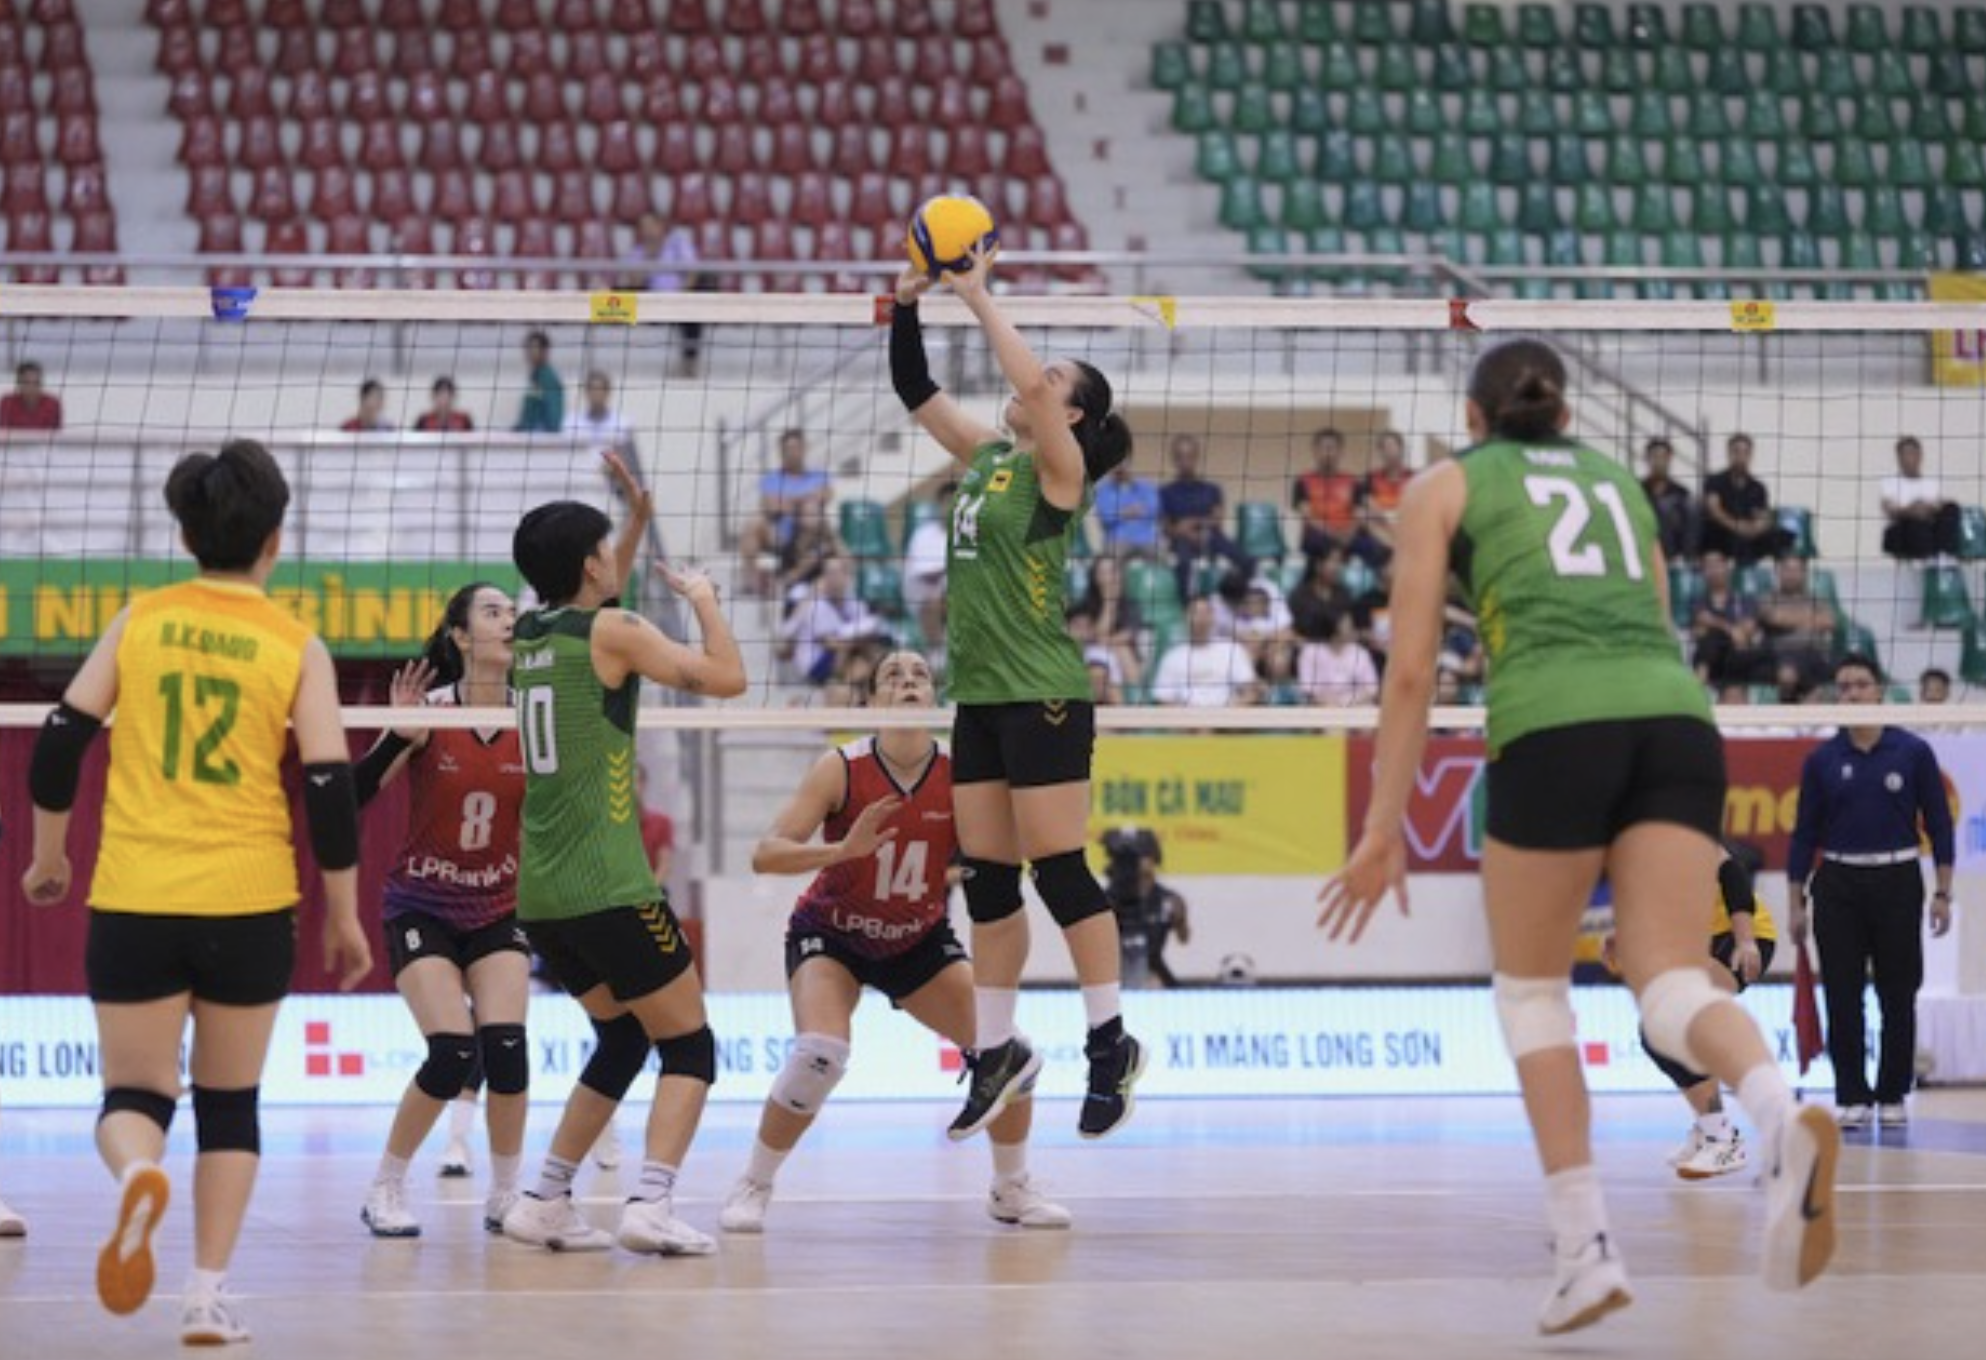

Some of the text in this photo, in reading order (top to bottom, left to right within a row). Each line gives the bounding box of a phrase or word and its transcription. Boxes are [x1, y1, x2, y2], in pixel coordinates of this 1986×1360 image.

[953, 492, 985, 547] 14
[1523, 474, 1643, 581] 21
[159, 671, 242, 787] 12
[516, 684, 559, 775] 10
[460, 791, 497, 851] 8
[874, 840, 929, 903] 14
[405, 928, 422, 950] 8
[800, 937, 824, 955] 14
[832, 907, 924, 940] LPBank
[39, 1041, 104, 1077] LON
[540, 1037, 568, 1073] XI
[1167, 1033, 1194, 1068] XI
[1301, 1033, 1374, 1068] LONG
[1384, 1030, 1442, 1068] SƠN
